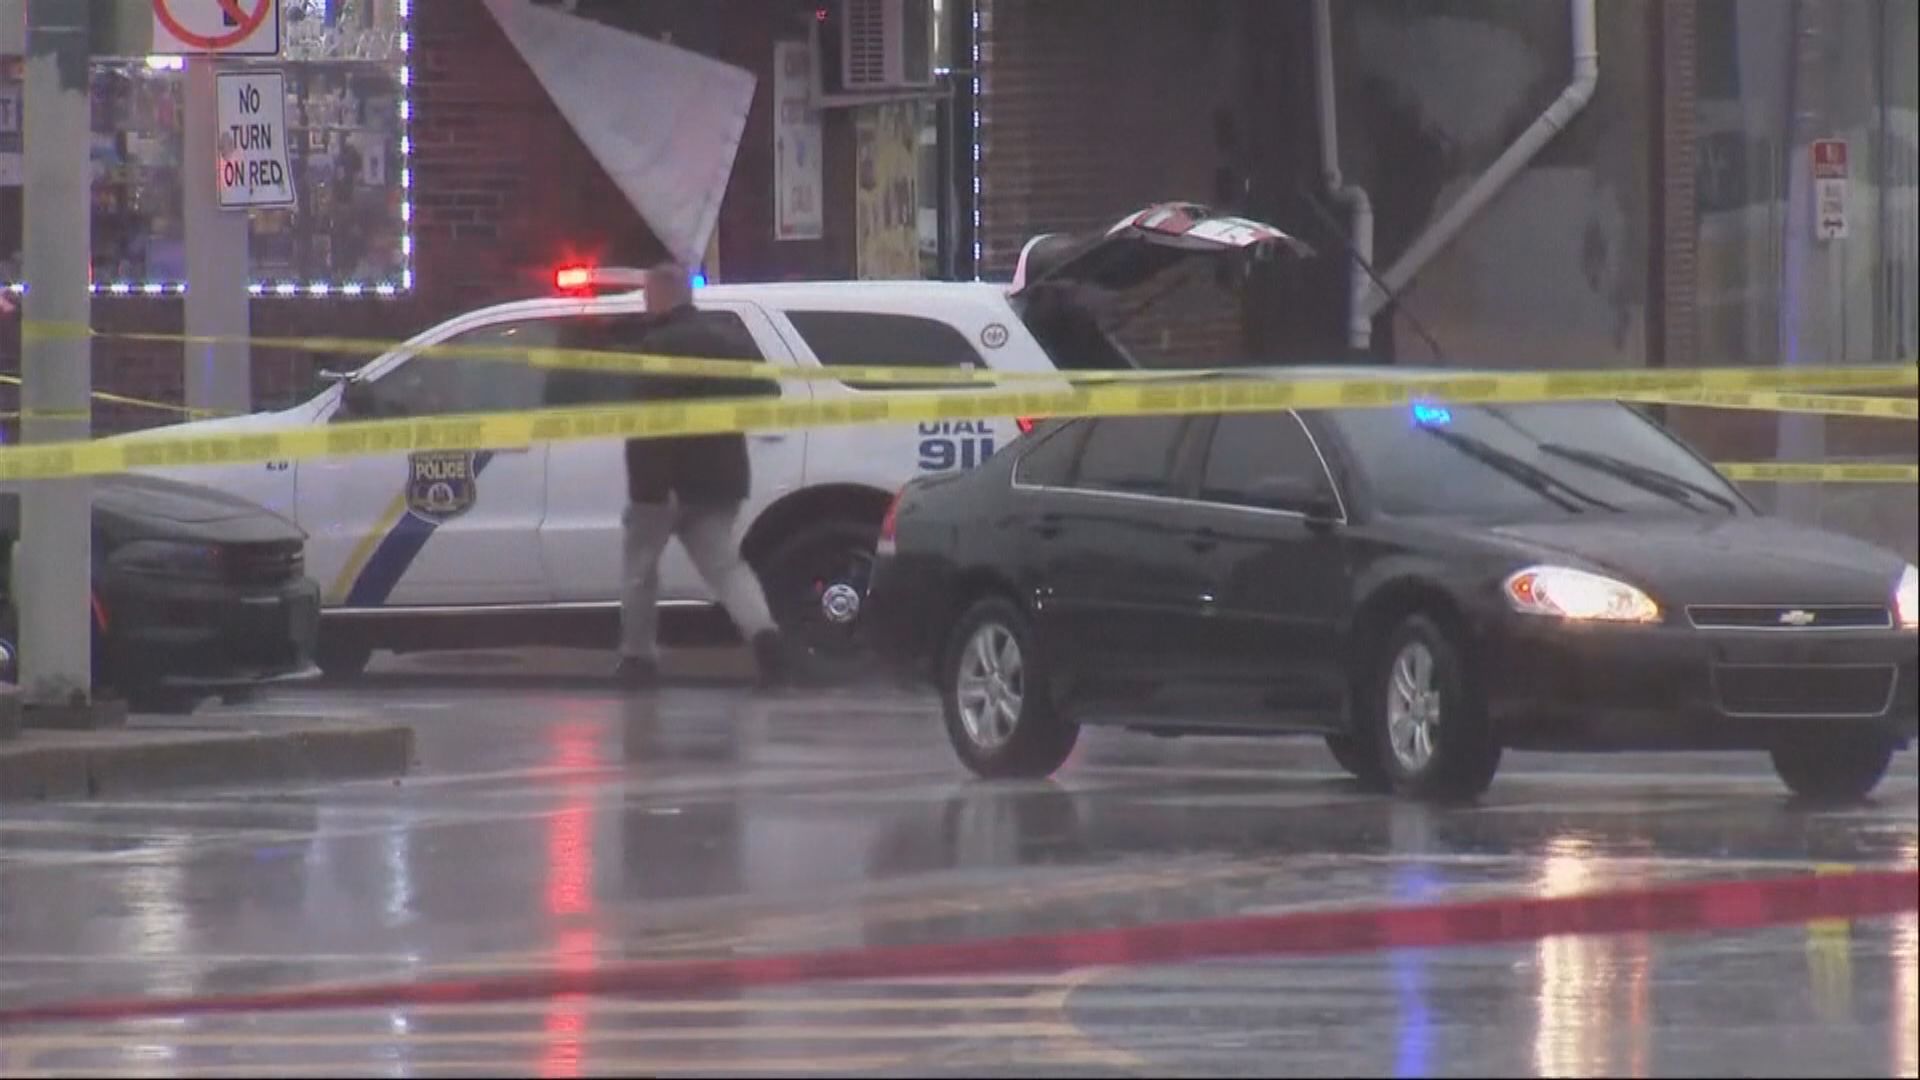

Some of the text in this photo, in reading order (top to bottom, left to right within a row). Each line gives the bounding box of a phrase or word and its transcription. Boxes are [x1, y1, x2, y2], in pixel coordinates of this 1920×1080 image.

[240, 86, 260, 113] NO
[231, 124, 271, 149] TURN
[225, 160, 283, 187] ON RED
[919, 420, 993, 434] DIAL
[919, 438, 994, 469] 911
[416, 461, 465, 479] POLICE
